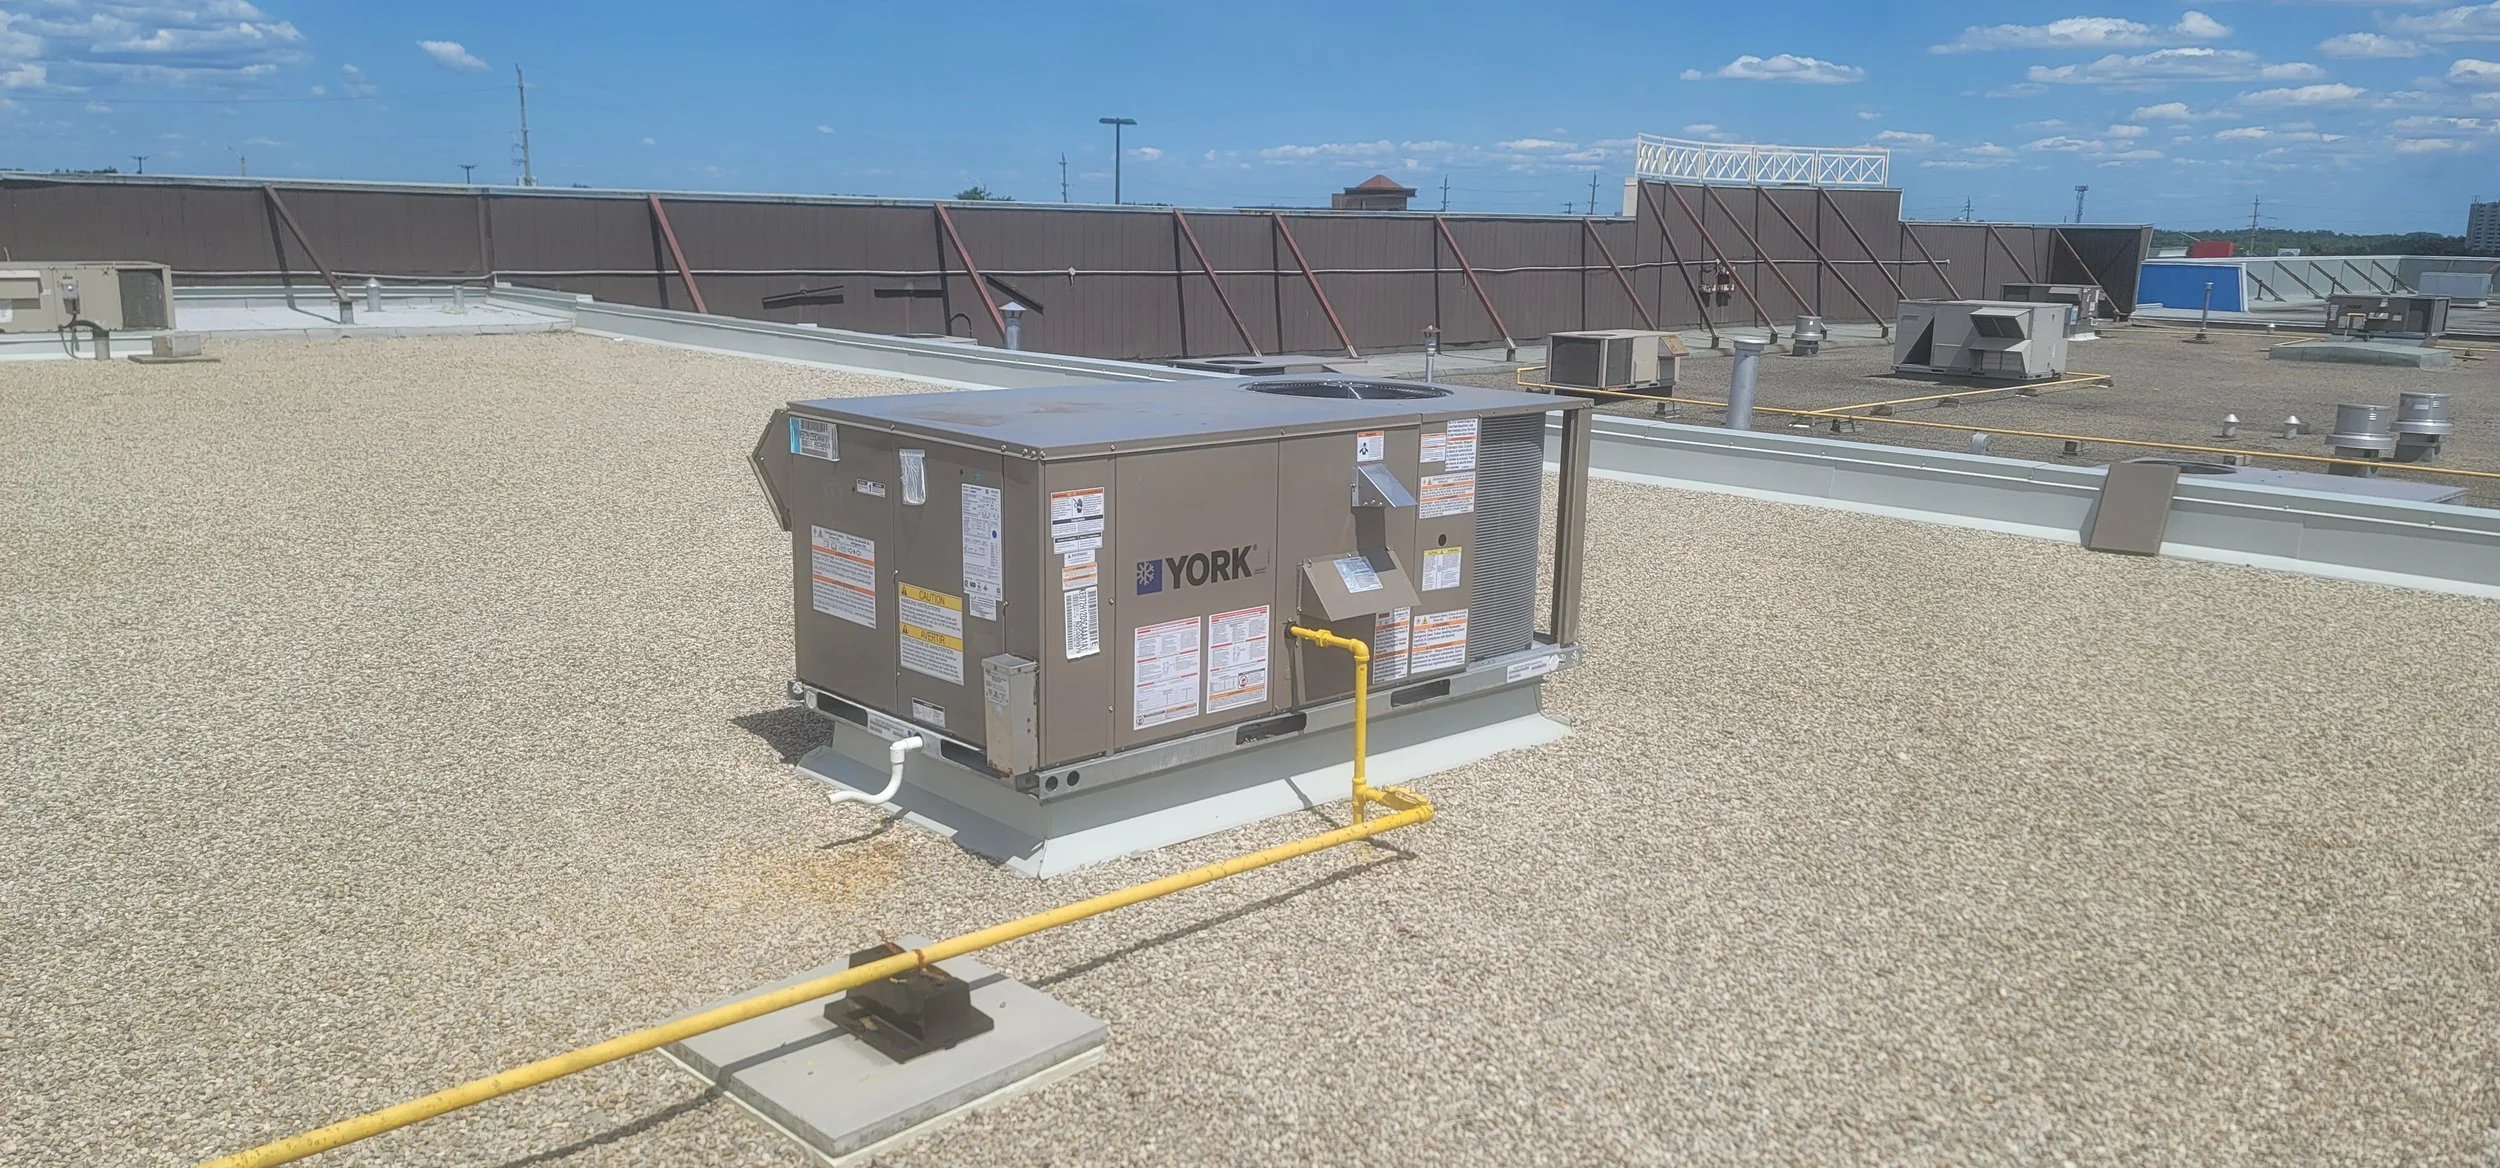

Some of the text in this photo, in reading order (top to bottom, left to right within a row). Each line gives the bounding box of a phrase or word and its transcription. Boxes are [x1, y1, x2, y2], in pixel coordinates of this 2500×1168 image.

[1165, 545, 1252, 589] YORK
[919, 590, 945, 605] CAUTION
[921, 630, 945, 645] AVERTIR
